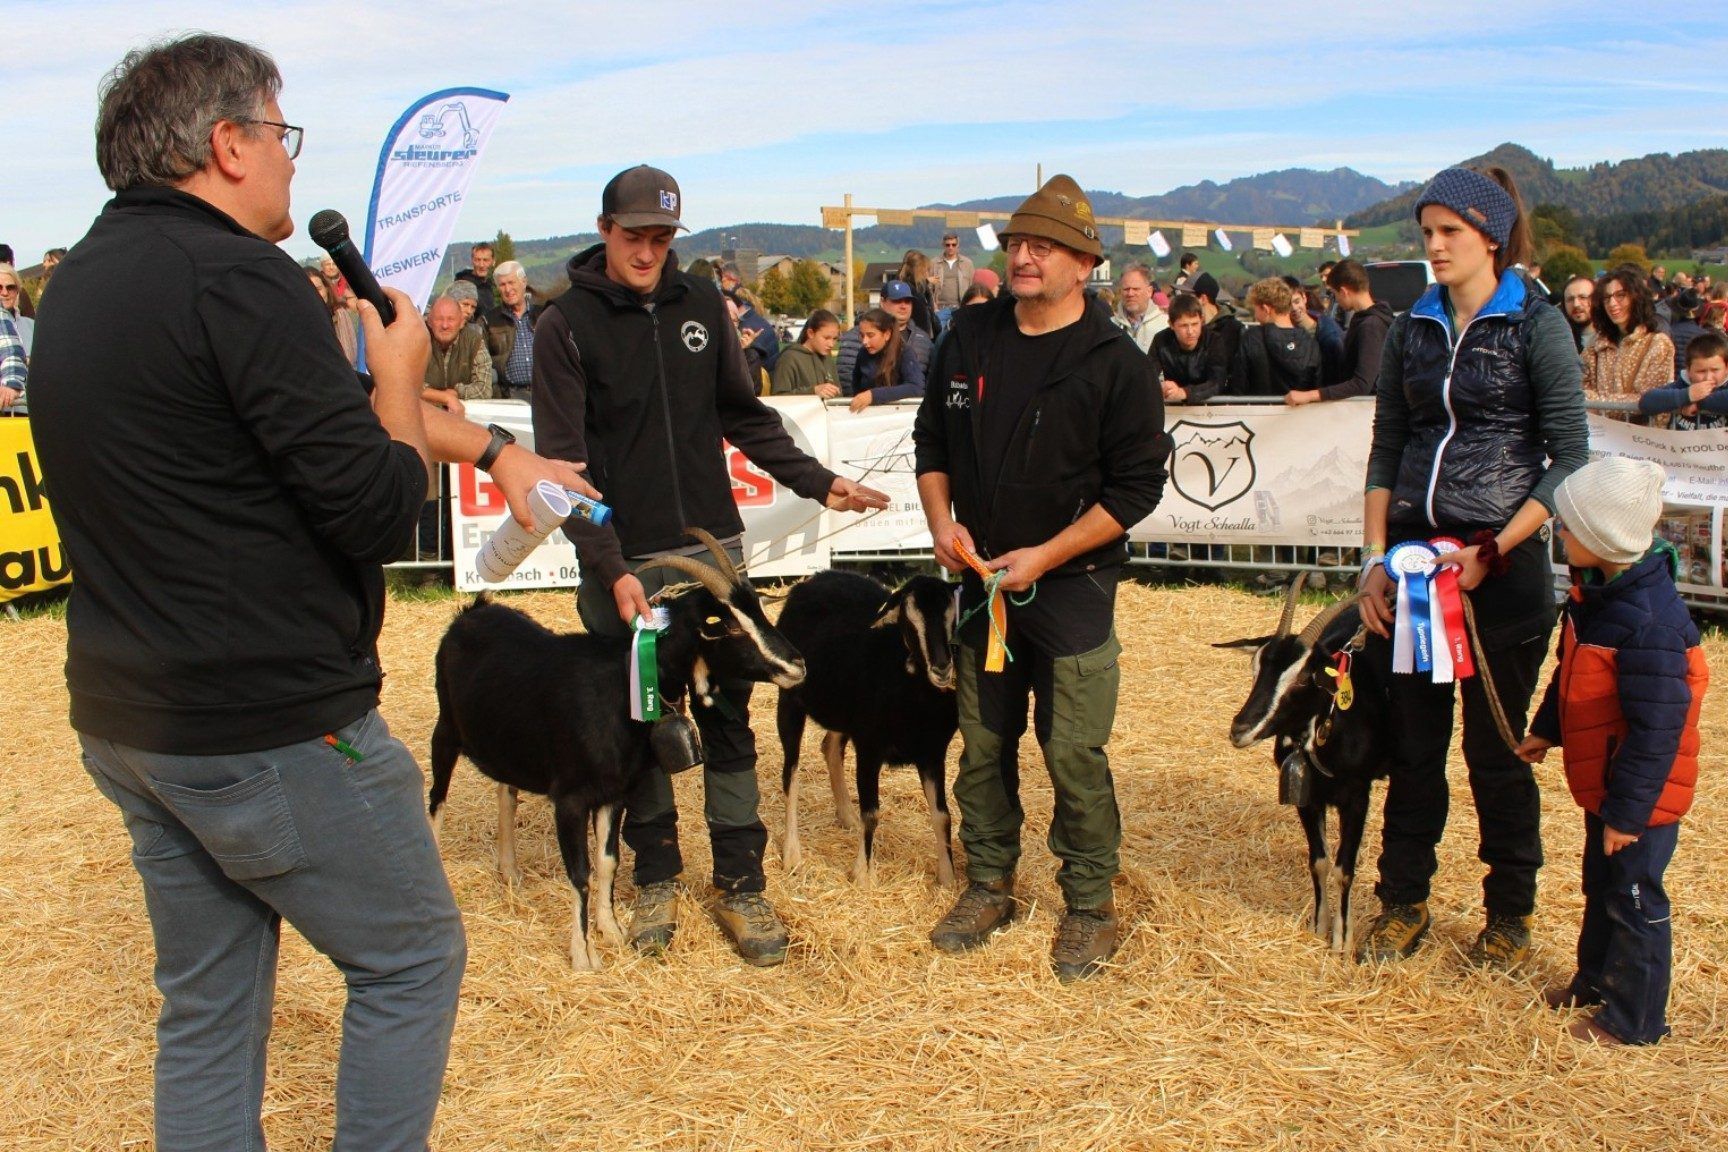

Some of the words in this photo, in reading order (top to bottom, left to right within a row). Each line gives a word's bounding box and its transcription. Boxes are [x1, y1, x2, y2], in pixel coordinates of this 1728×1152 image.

[391, 144, 477, 161] steurer
[377, 191, 462, 230] TRANSPORTE
[372, 248, 440, 279] KIESWERK
[1166, 514, 1201, 530] Vogt
[1204, 516, 1256, 530] Schealla
